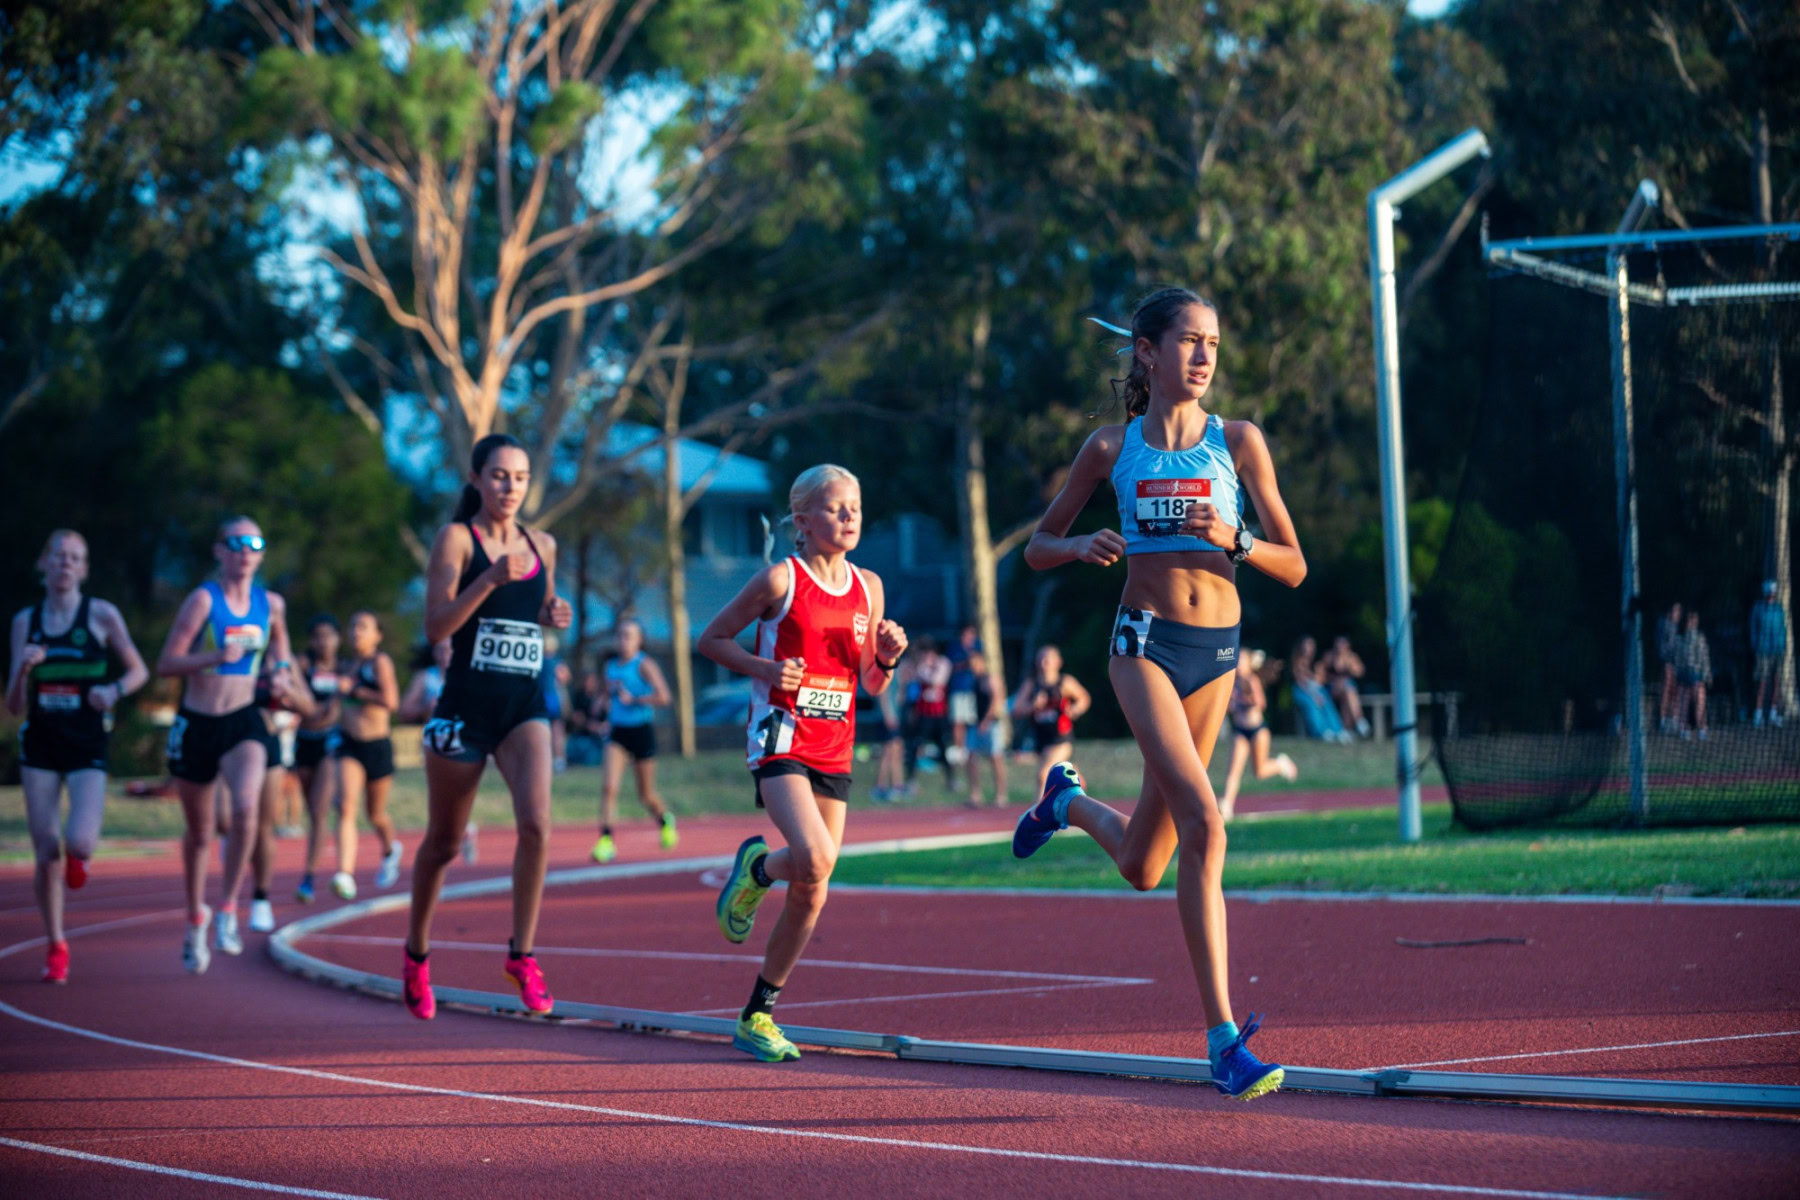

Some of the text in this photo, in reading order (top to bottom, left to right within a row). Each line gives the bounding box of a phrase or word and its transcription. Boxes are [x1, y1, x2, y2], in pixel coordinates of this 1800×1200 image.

[1179, 483, 1202, 491] WORLD
[480, 637, 539, 662] 9008
[808, 691, 843, 709] 2213
